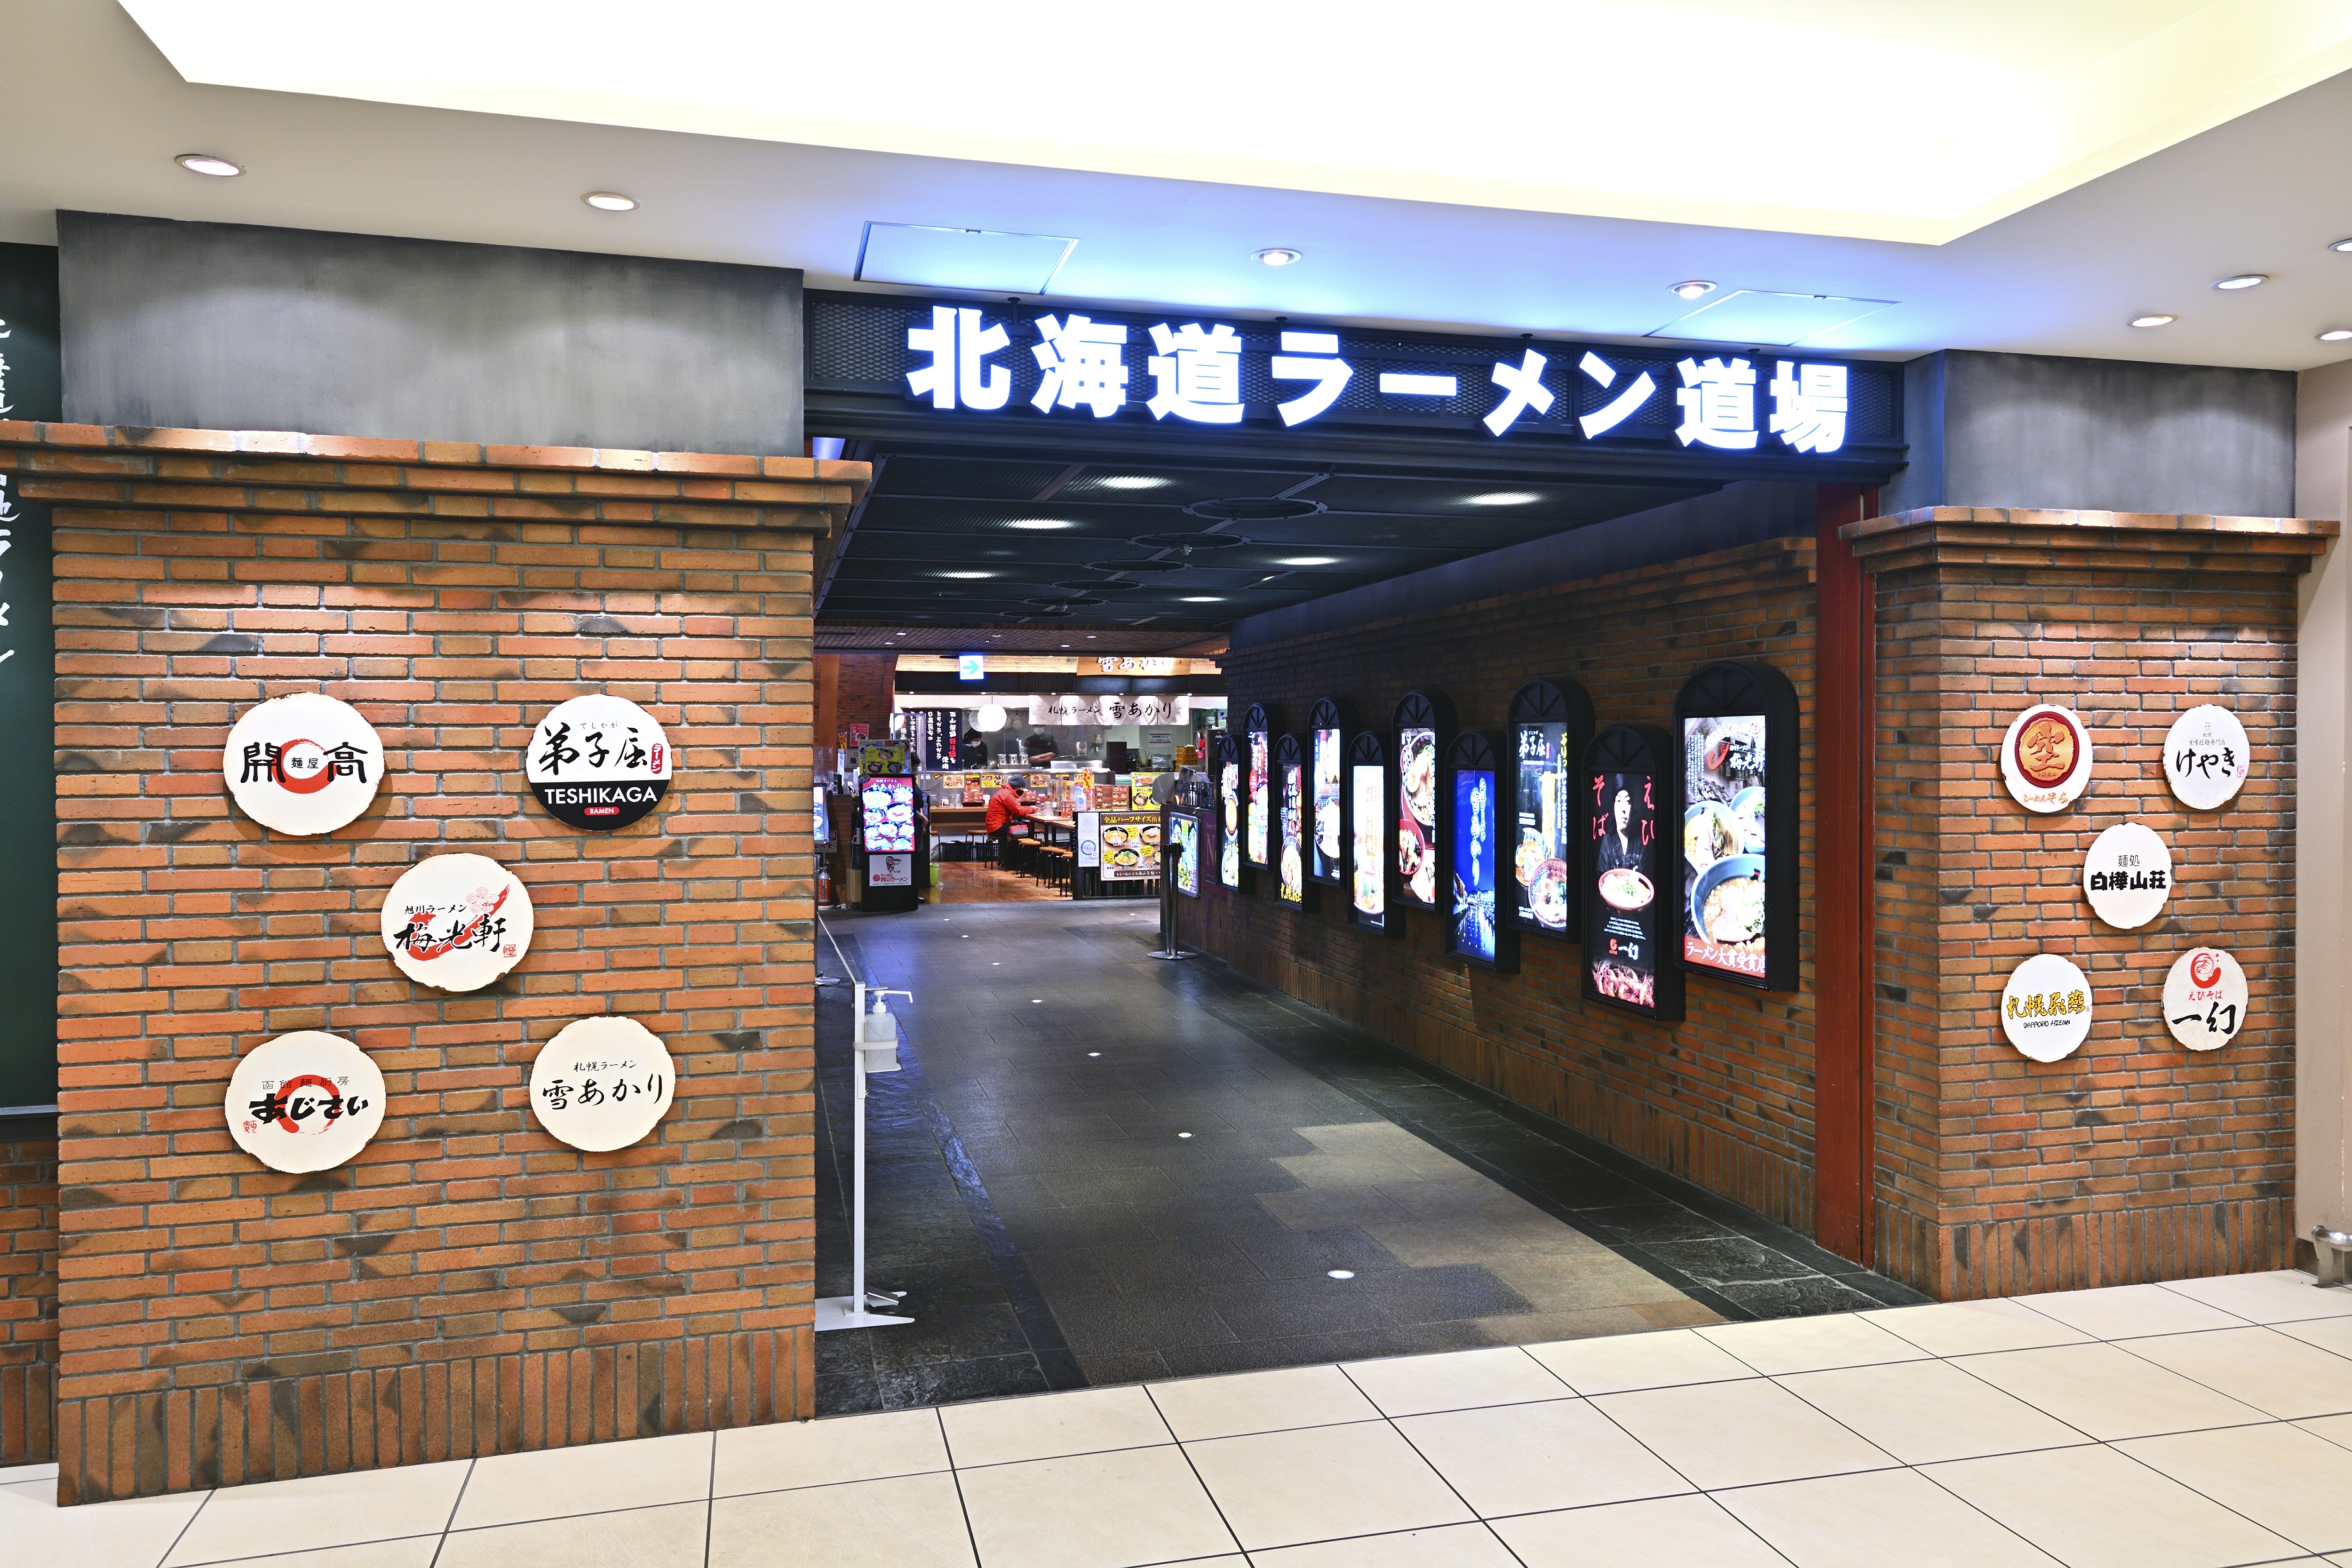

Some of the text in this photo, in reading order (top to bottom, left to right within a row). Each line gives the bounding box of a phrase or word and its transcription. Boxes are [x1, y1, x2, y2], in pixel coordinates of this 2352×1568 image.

[906, 306, 1849, 454] 北海道ラーメン道場
[1098, 657, 1175, 672] 雪あかり
[1048, 706, 1101, 715] 札幌ラーメン
[1110, 702, 1171, 718] 雪あかり
[539, 722, 647, 775] 弟子屈
[2026, 721, 2065, 771] 空
[652, 744, 662, 772] ラーメン
[2176, 747, 2235, 779] けやき
[544, 786, 657, 804] TESHIKAGA
[2118, 855, 2140, 867] 麺処
[2090, 870, 2167, 891] 白樺山荘
[405, 904, 467, 914] 旭川ラーメン
[393, 914, 507, 952] 梅光軒
[1618, 942, 1639, 960] 一幻
[2188, 990, 2224, 1001] えびそば
[2172, 1002, 2236, 1034] 一幻
[573, 1060, 637, 1072] 札幌ラーメン
[542, 1073, 662, 1110] 雪あかり
[249, 1093, 368, 1124] あじさい
